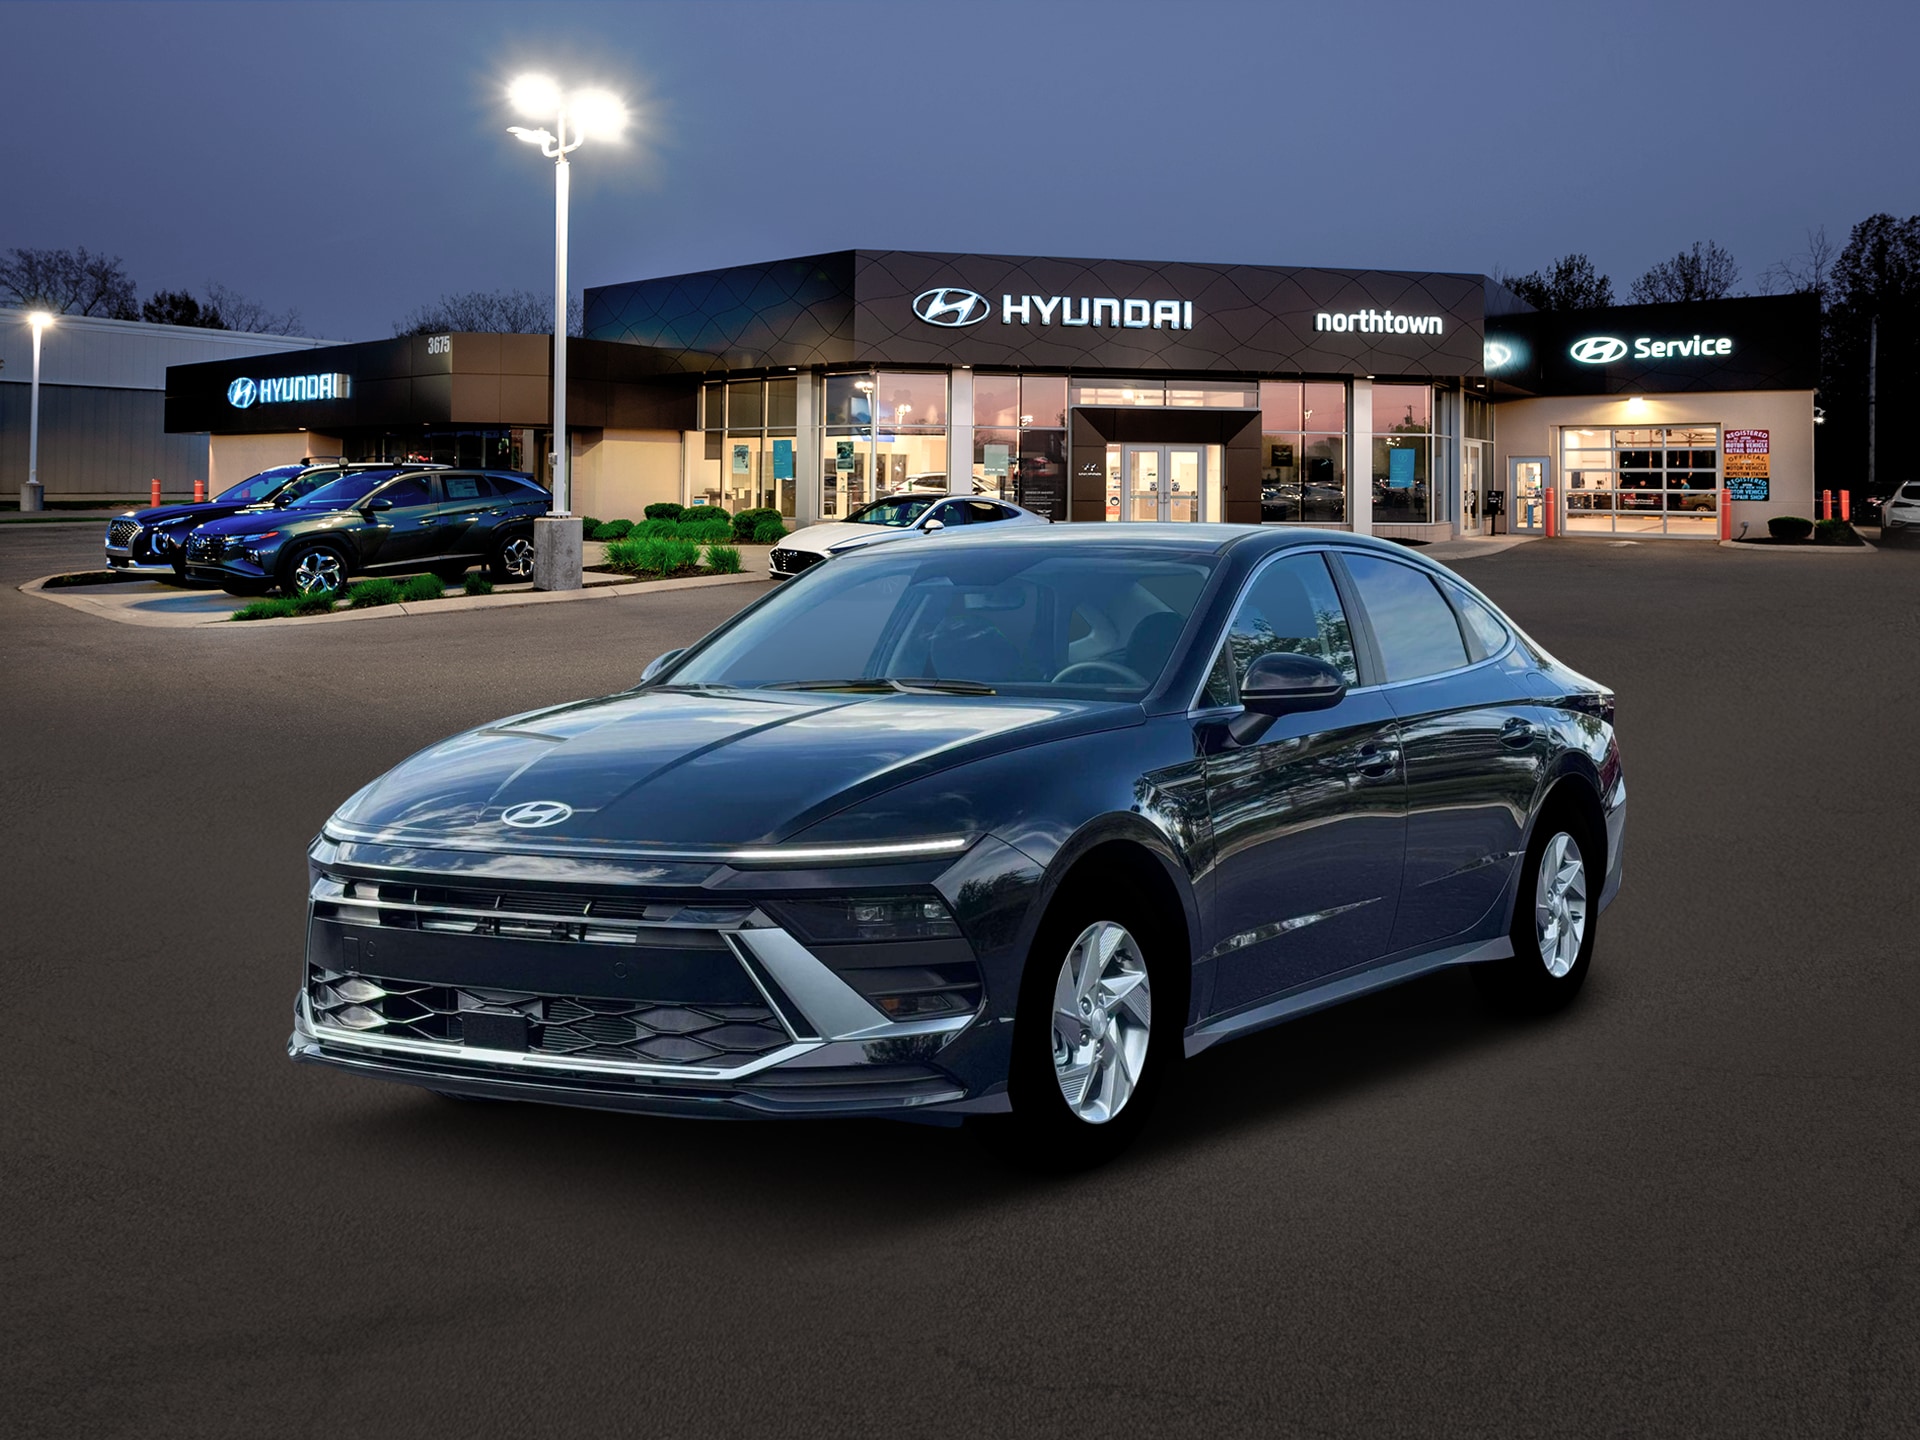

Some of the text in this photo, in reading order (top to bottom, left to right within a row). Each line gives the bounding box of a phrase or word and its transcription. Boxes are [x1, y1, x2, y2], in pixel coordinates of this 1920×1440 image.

[1001, 294, 1193, 330] HYUNDAI
[1316, 309, 1443, 335] northtown
[428, 335, 451, 355] 3675
[1634, 334, 1733, 359] Service
[260, 372, 348, 404] HYUNDAI
[1726, 430, 1768, 439] REGISTERED
[1728, 454, 1766, 462] OFFICIAL
[1726, 477, 1767, 486] REGISTERED
